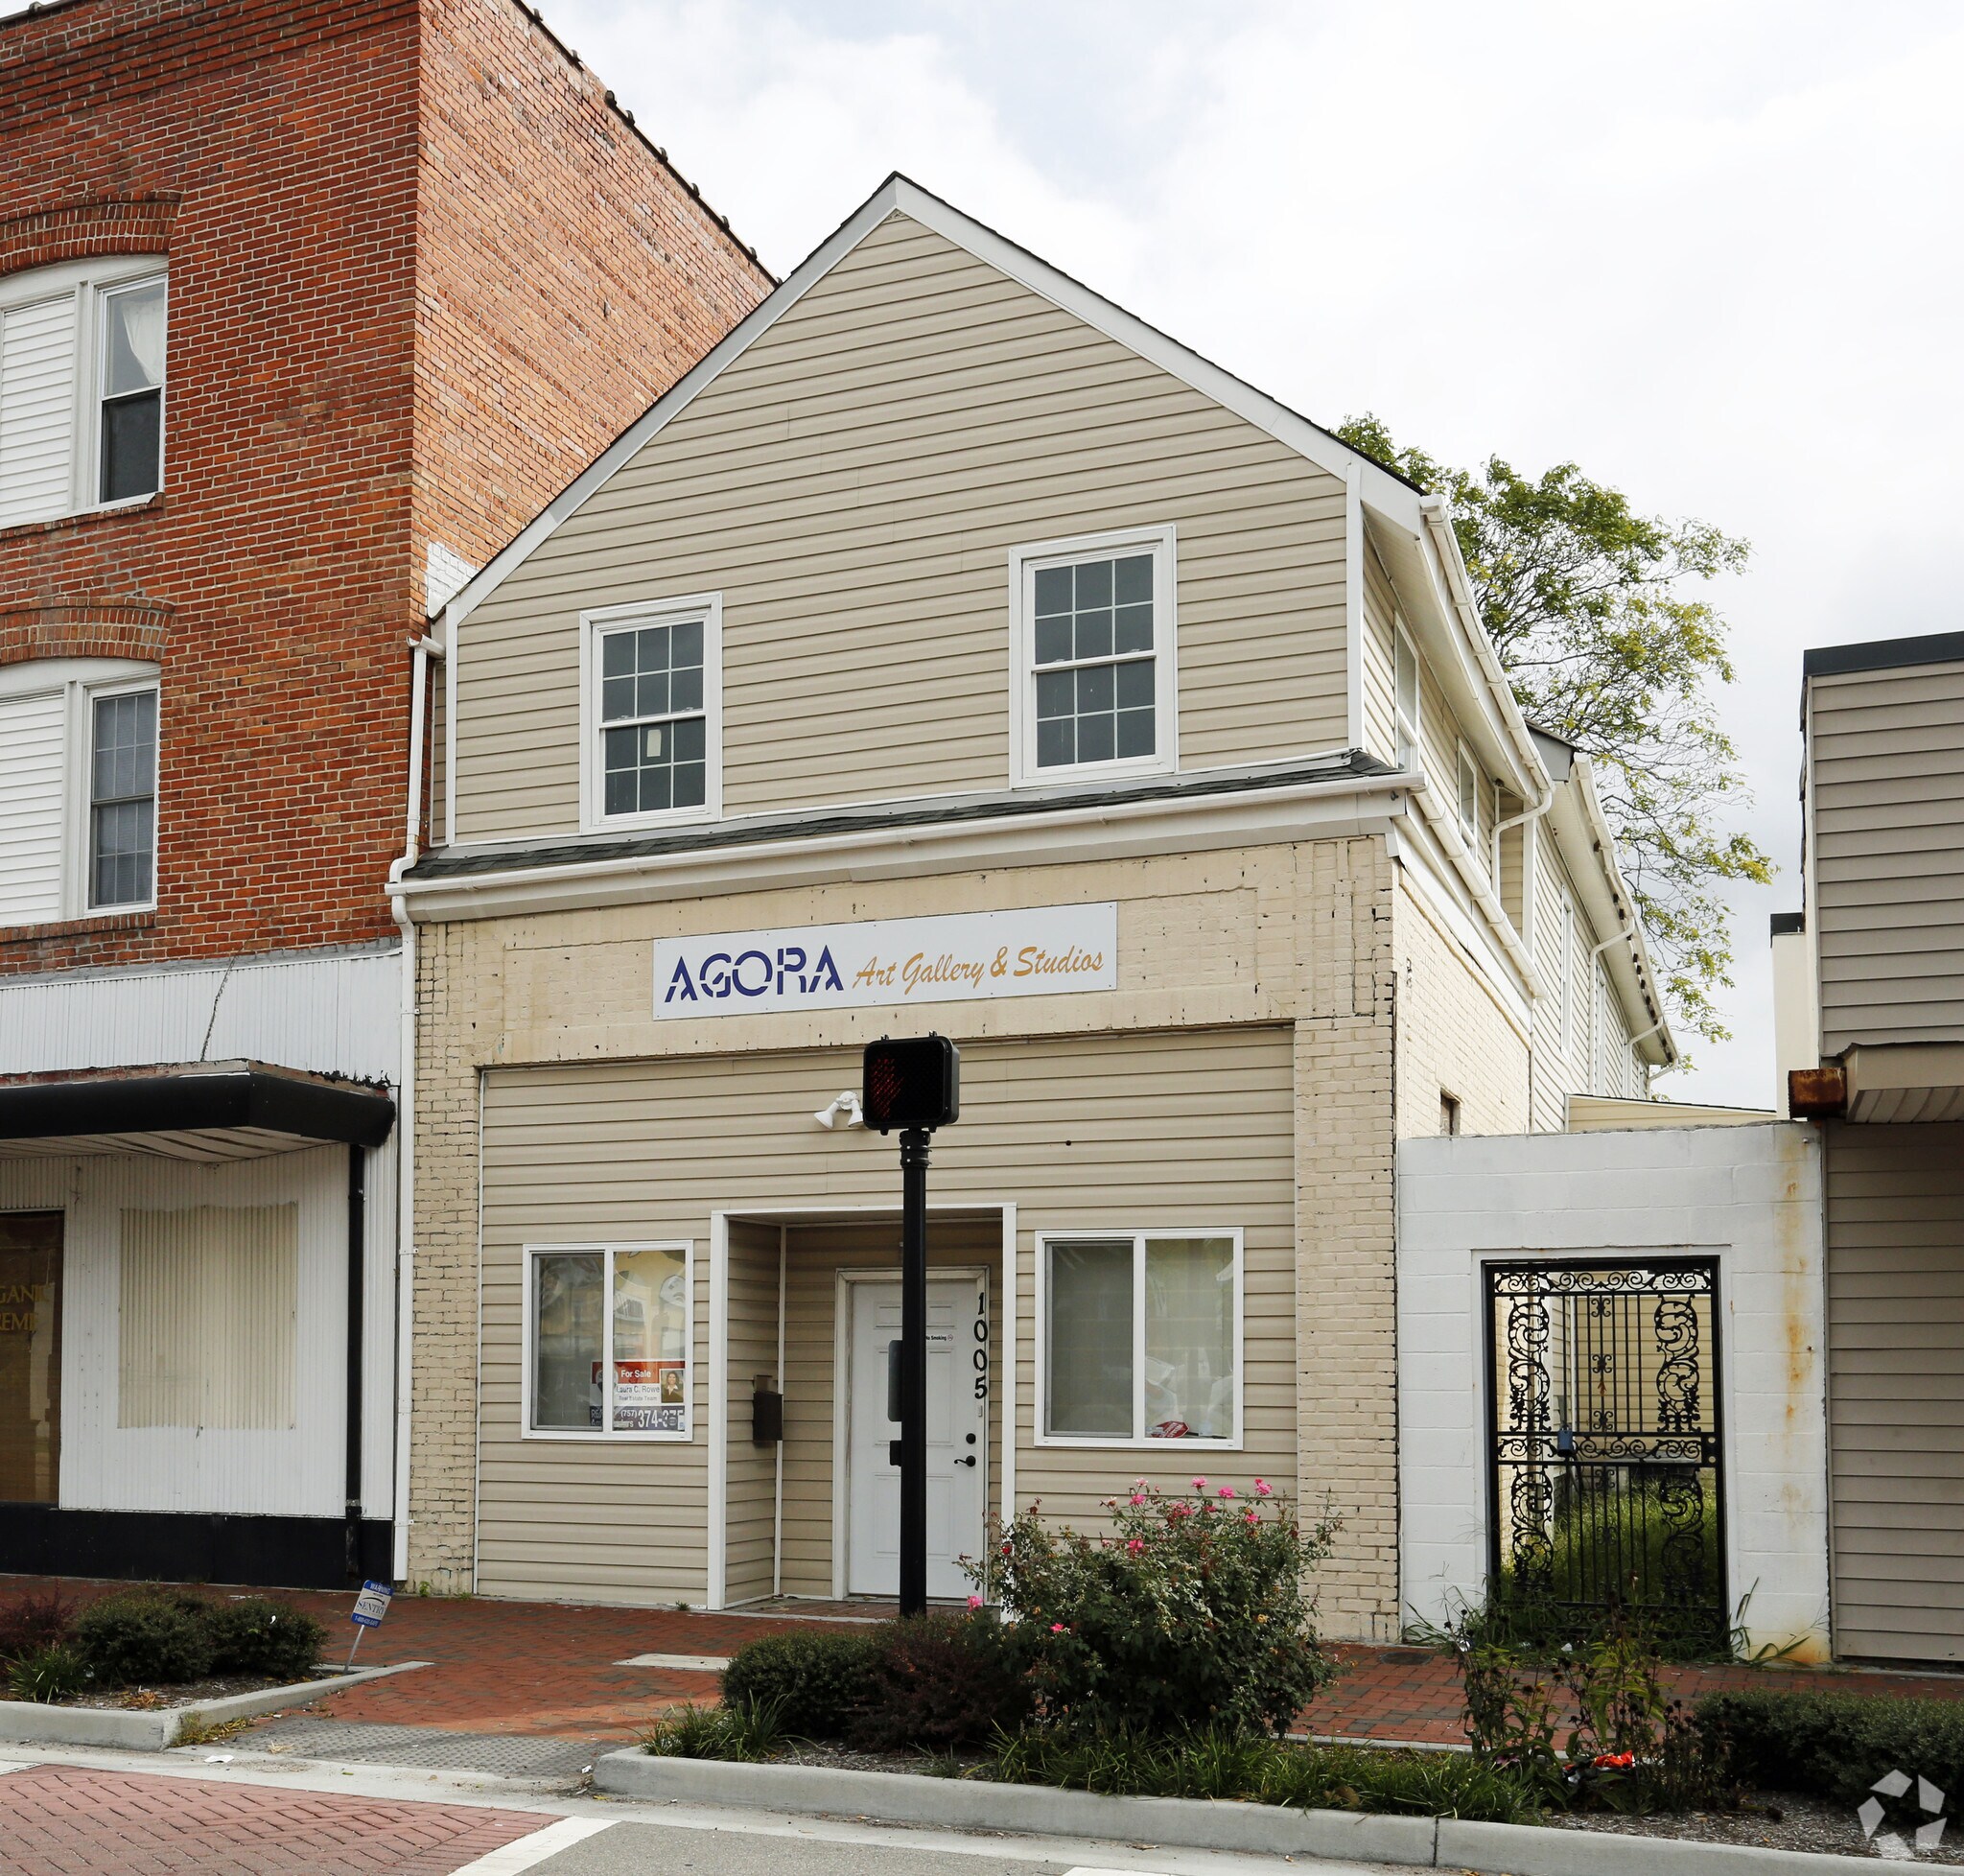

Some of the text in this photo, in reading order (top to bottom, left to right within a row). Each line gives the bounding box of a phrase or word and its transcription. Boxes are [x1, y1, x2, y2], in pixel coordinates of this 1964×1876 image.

[665, 945, 1104, 1002] AGORA Art Gallery & Studios
[973, 1292, 988, 1399] 1005
[620, 1370, 652, 1378] For Sale
[617, 1385, 633, 1394] Laura
[642, 1385, 660, 1394] Rowe
[620, 1410, 637, 1419] (757)
[370, 1583, 391, 1595] WARNING
[357, 1601, 386, 1615] SENTRY
